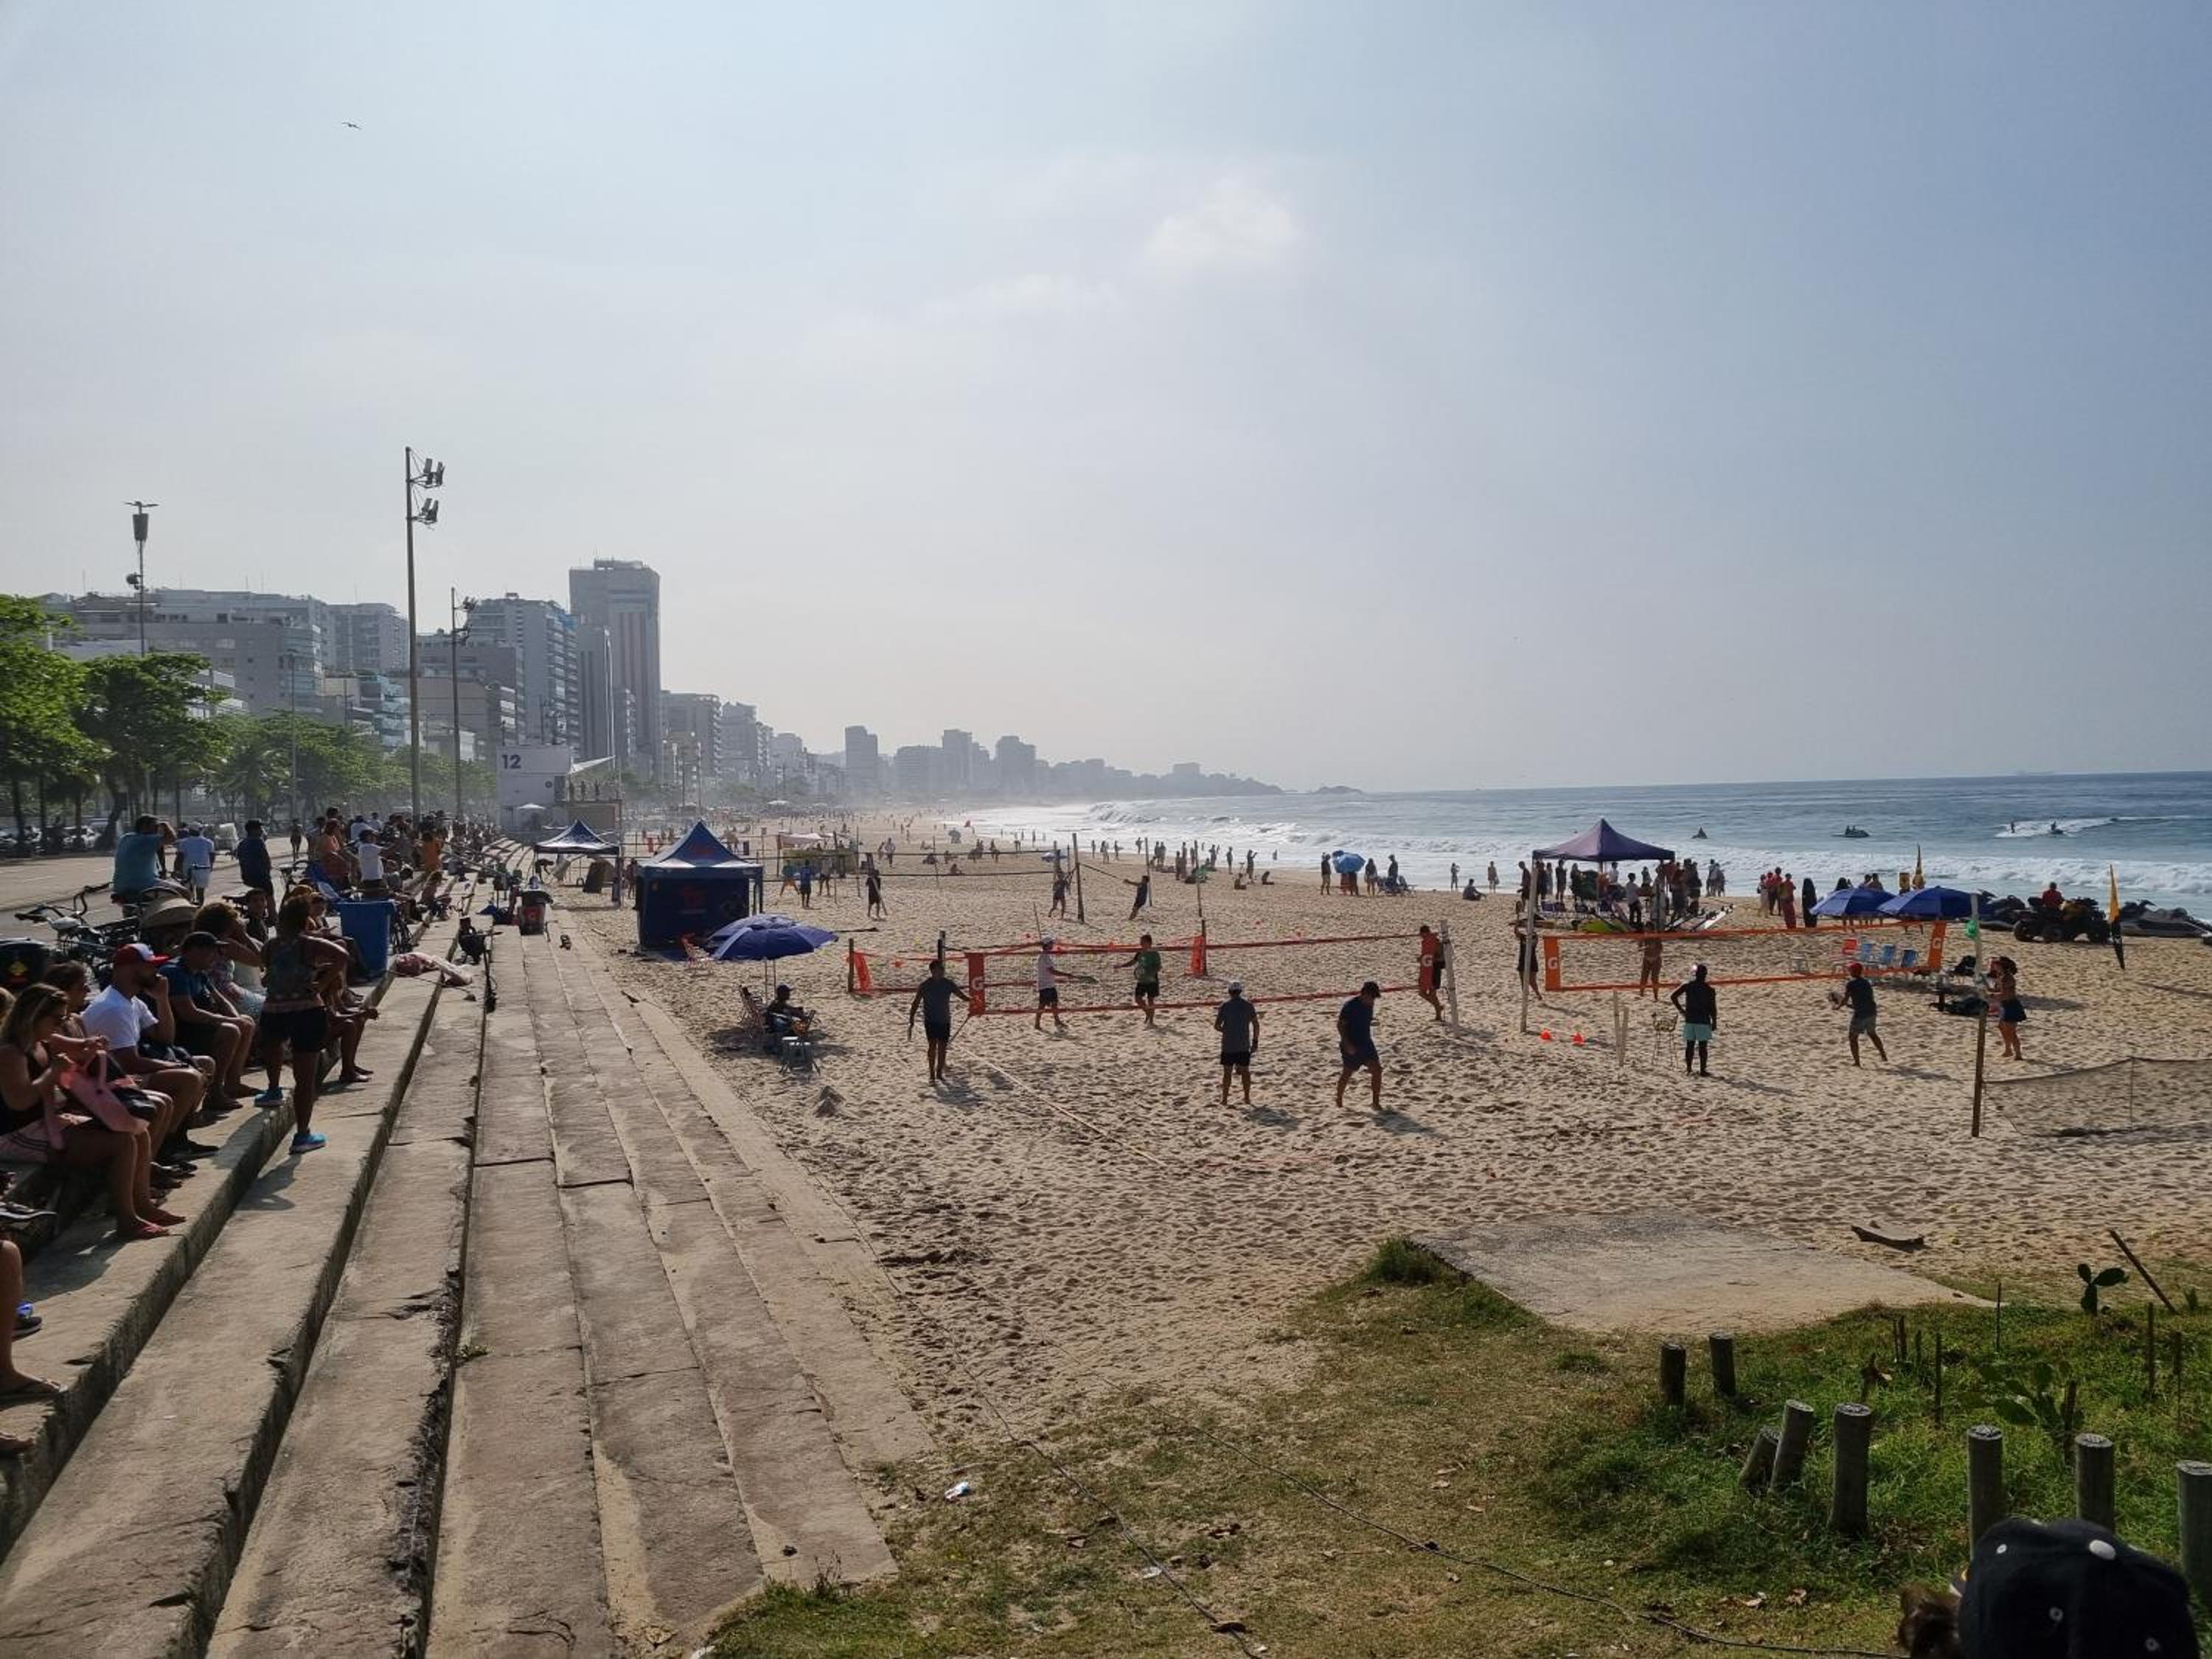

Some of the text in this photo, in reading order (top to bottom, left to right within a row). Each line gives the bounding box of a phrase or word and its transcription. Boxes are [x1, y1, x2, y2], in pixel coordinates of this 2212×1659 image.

[501, 754, 521, 769] 12
[1422, 954, 1433, 967] G
[1548, 956, 1558, 970] G
[972, 976, 984, 991] G
